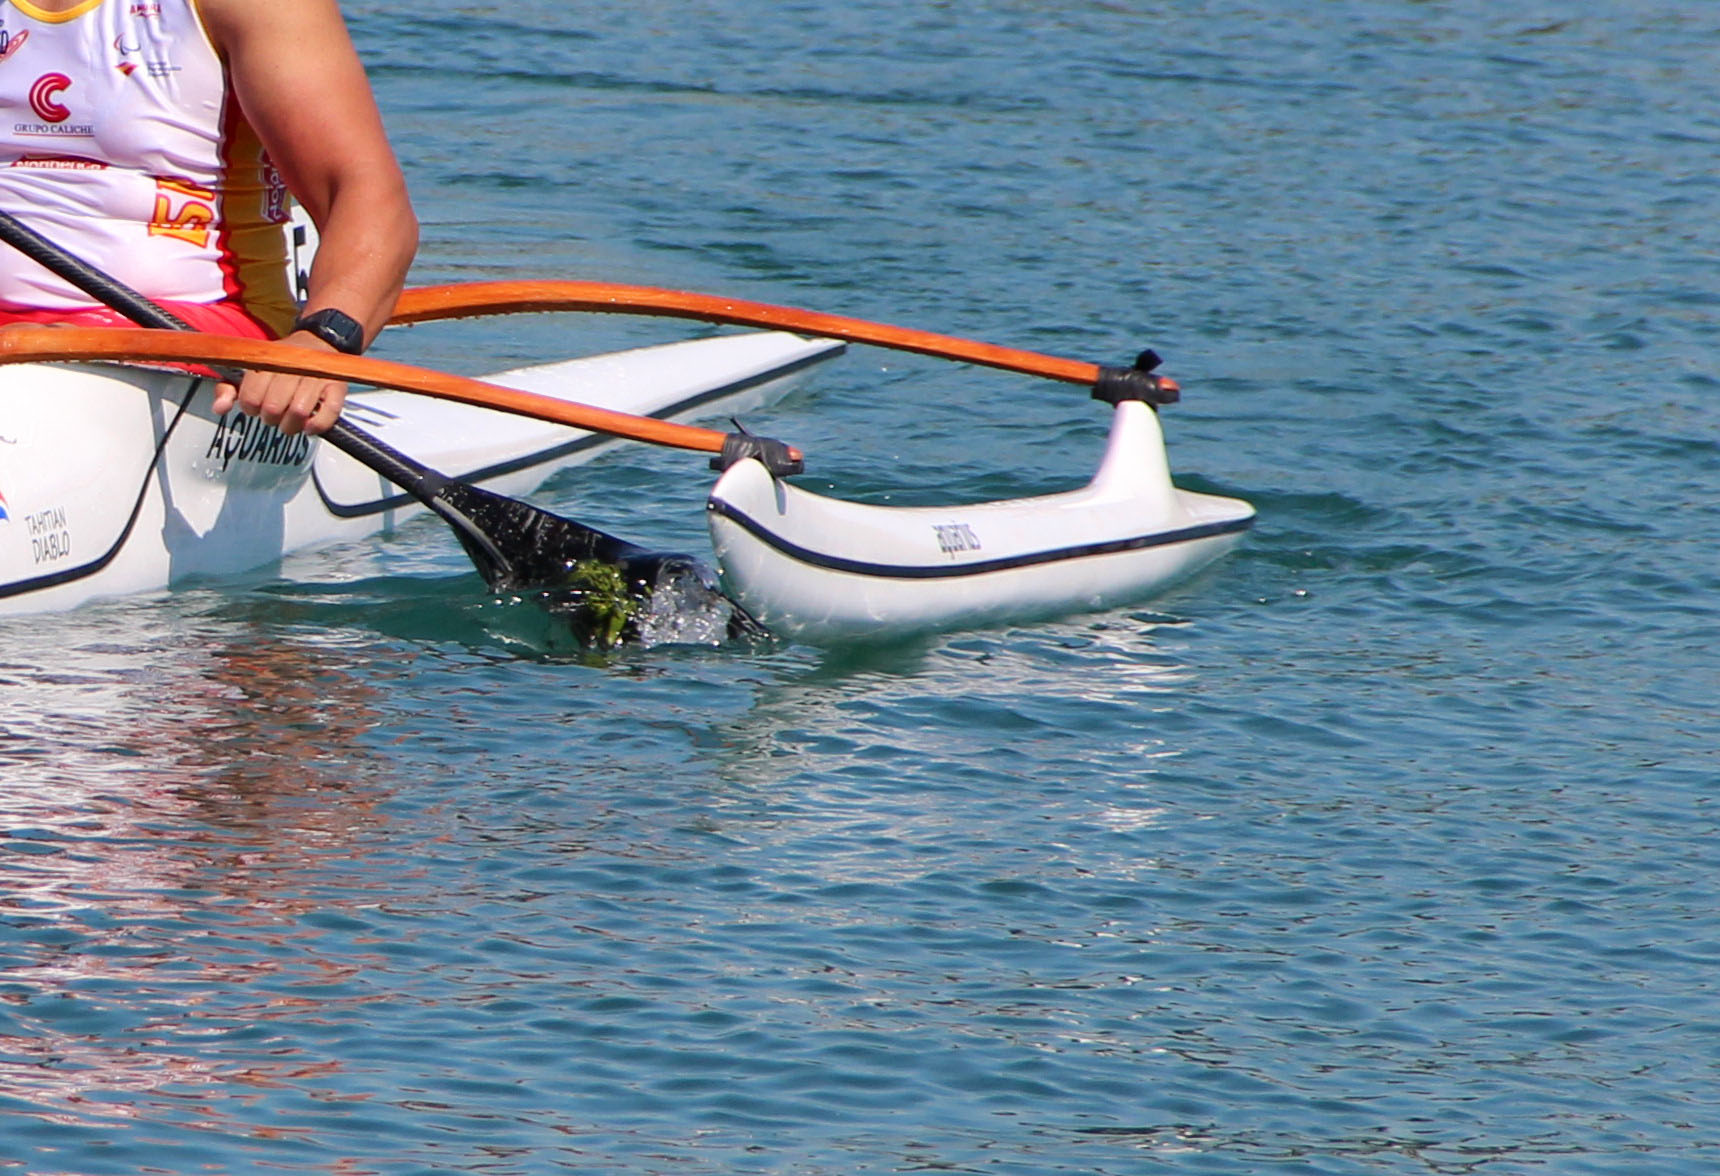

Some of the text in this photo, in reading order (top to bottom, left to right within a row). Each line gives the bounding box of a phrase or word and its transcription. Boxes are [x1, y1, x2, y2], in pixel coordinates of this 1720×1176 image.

[14, 124, 94, 134] GRUPO CALICHE
[25, 506, 67, 535] TAHITIAN
[32, 531, 70, 563] DIABLO
